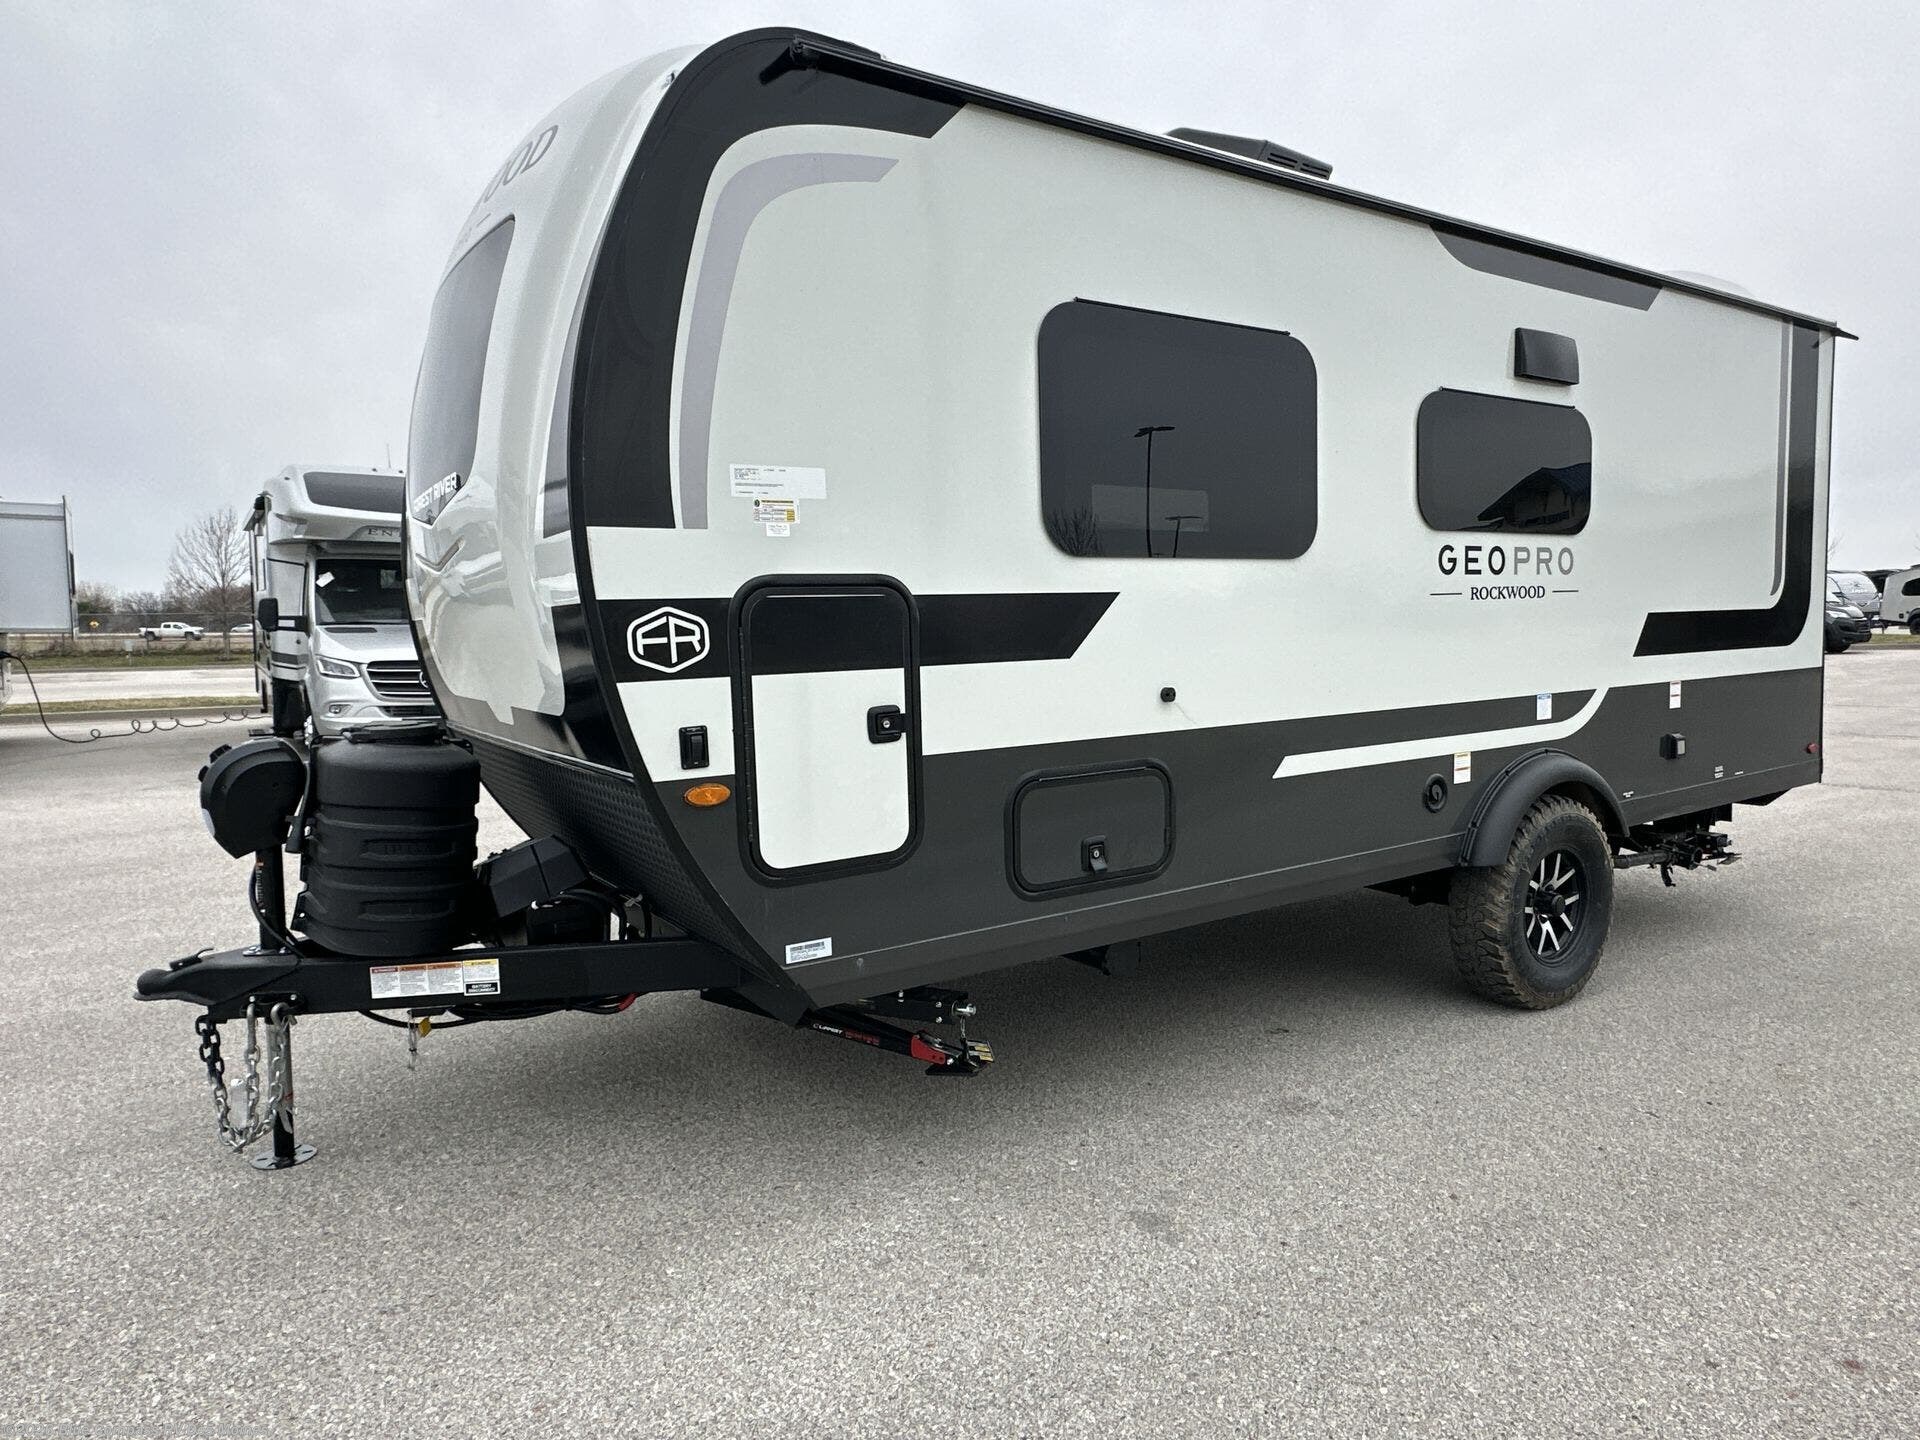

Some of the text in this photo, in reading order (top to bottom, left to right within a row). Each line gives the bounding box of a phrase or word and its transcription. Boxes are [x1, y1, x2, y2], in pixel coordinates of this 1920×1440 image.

[432, 472, 457, 501] RIVER
[1470, 585, 1546, 601] ROCKWOOD
[636, 615, 702, 664] FR
